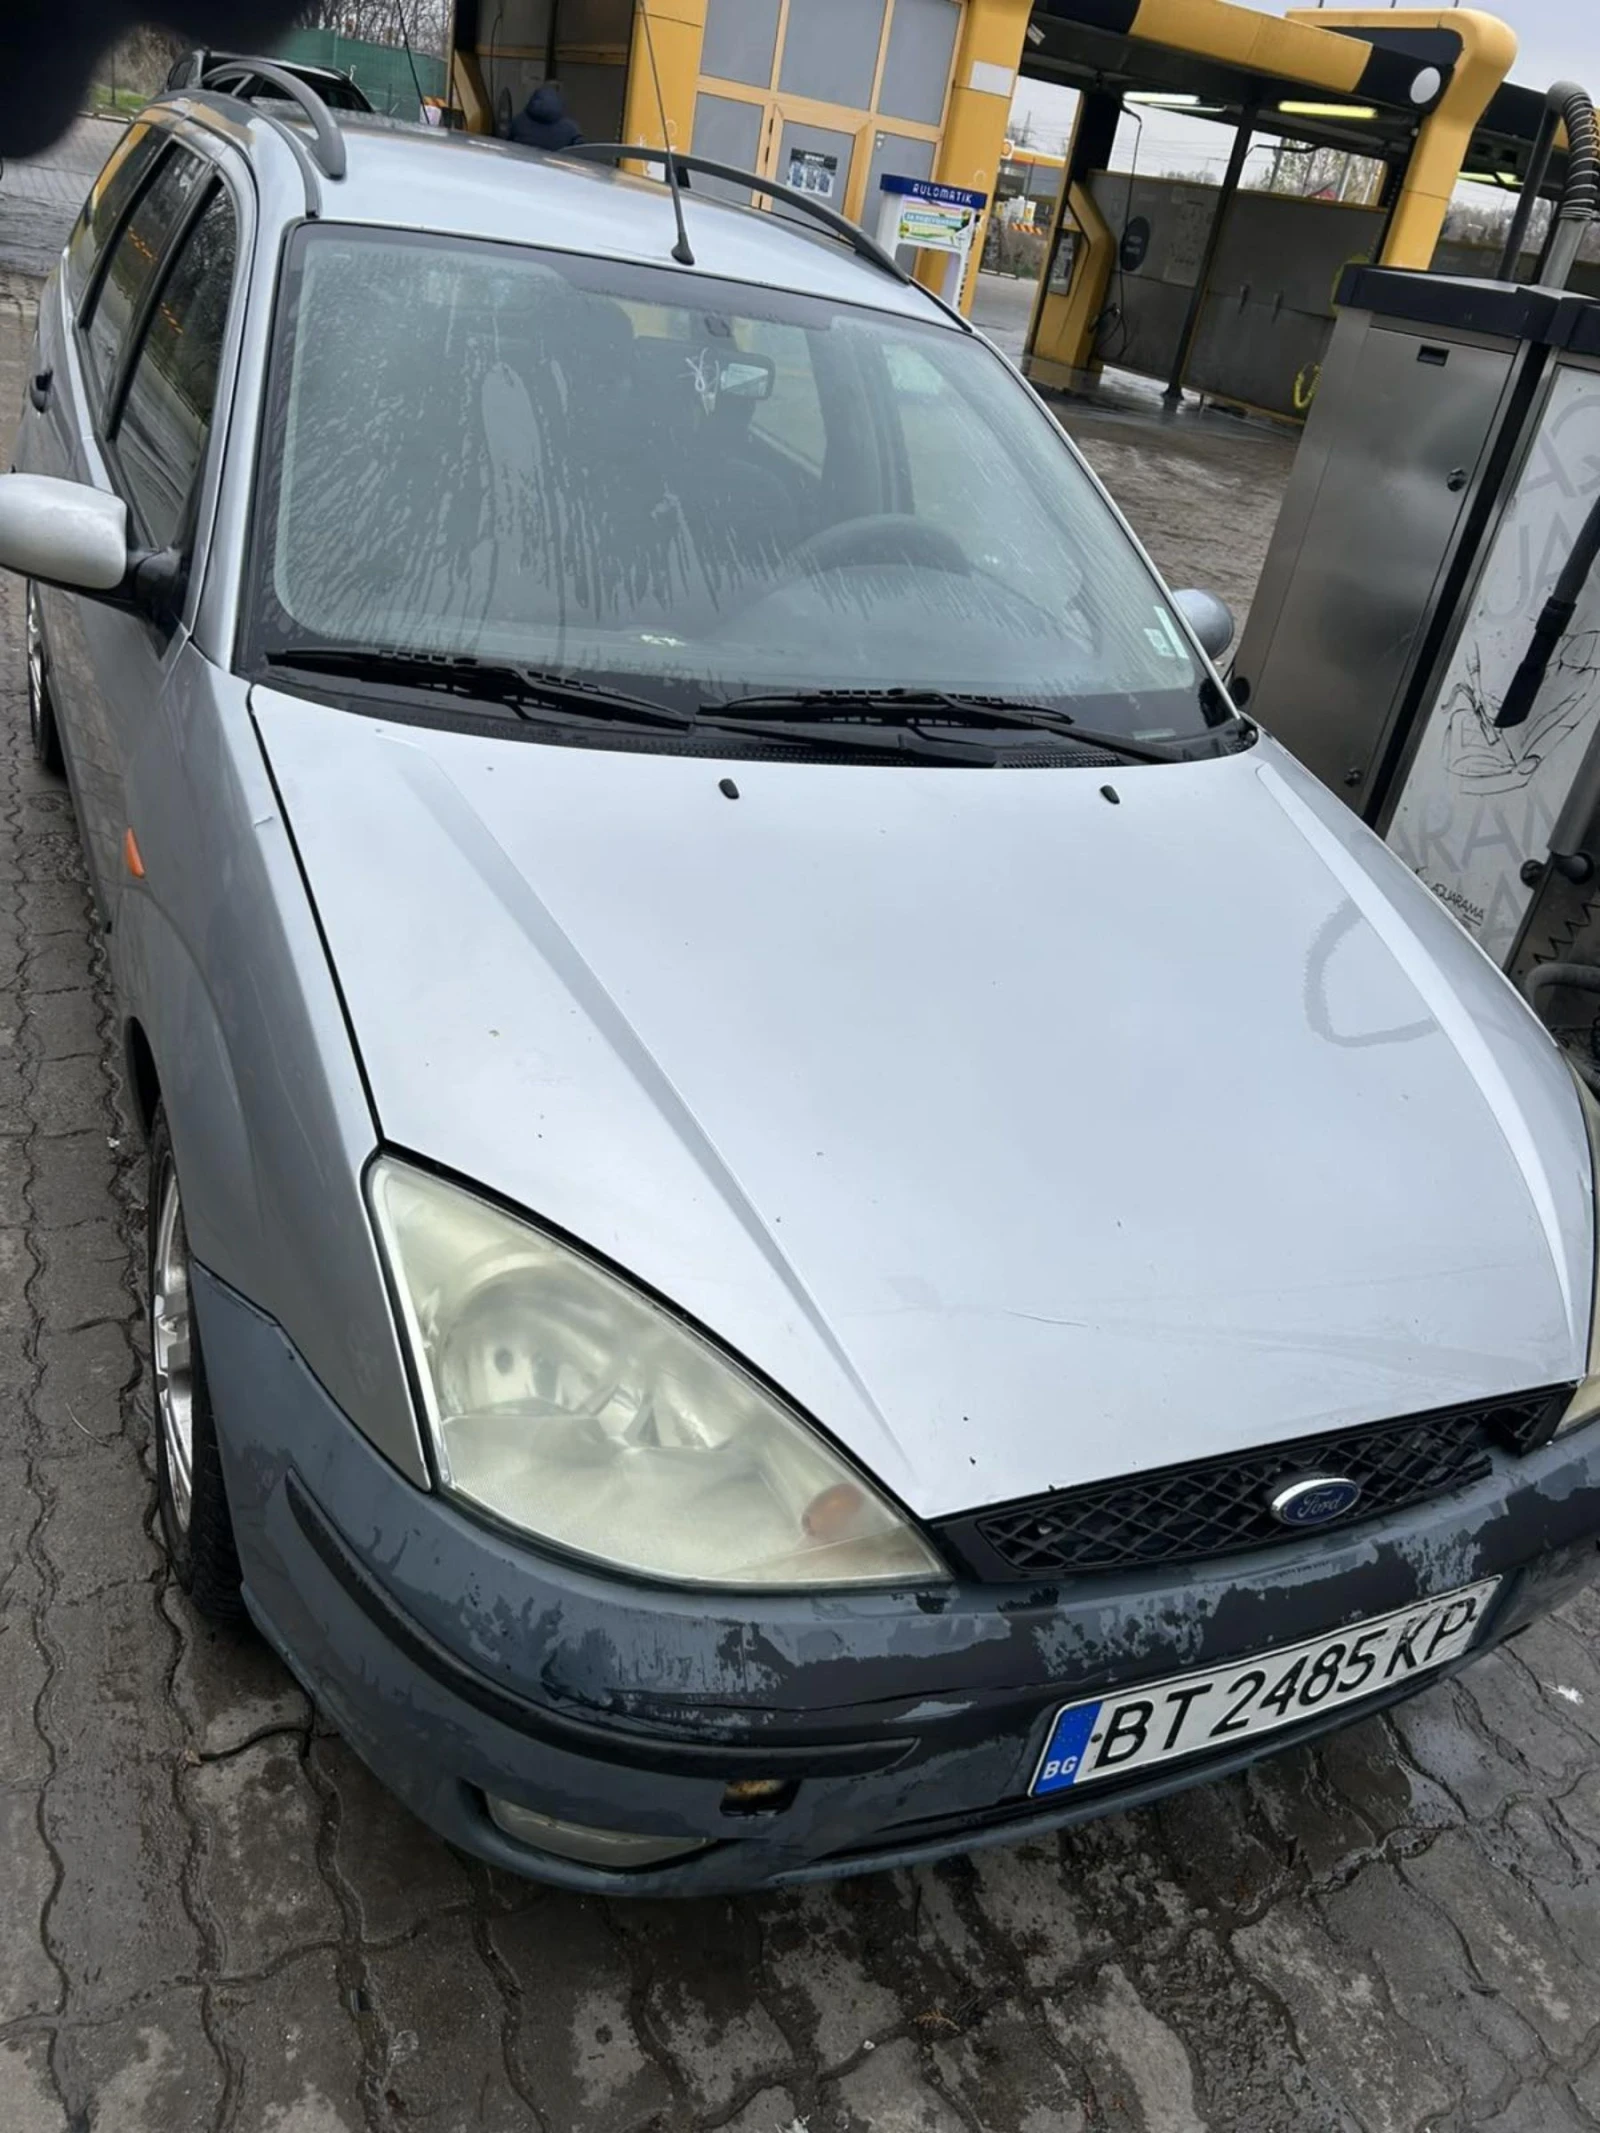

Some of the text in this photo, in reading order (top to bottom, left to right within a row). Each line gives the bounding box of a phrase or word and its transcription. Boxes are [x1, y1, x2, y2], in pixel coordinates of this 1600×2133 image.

[1297, 1490, 1344, 1518] Ford
[1094, 1683, 1213, 1769] BT
[1209, 1628, 1388, 1738] 2485
[1042, 1756, 1078, 1781] BG
